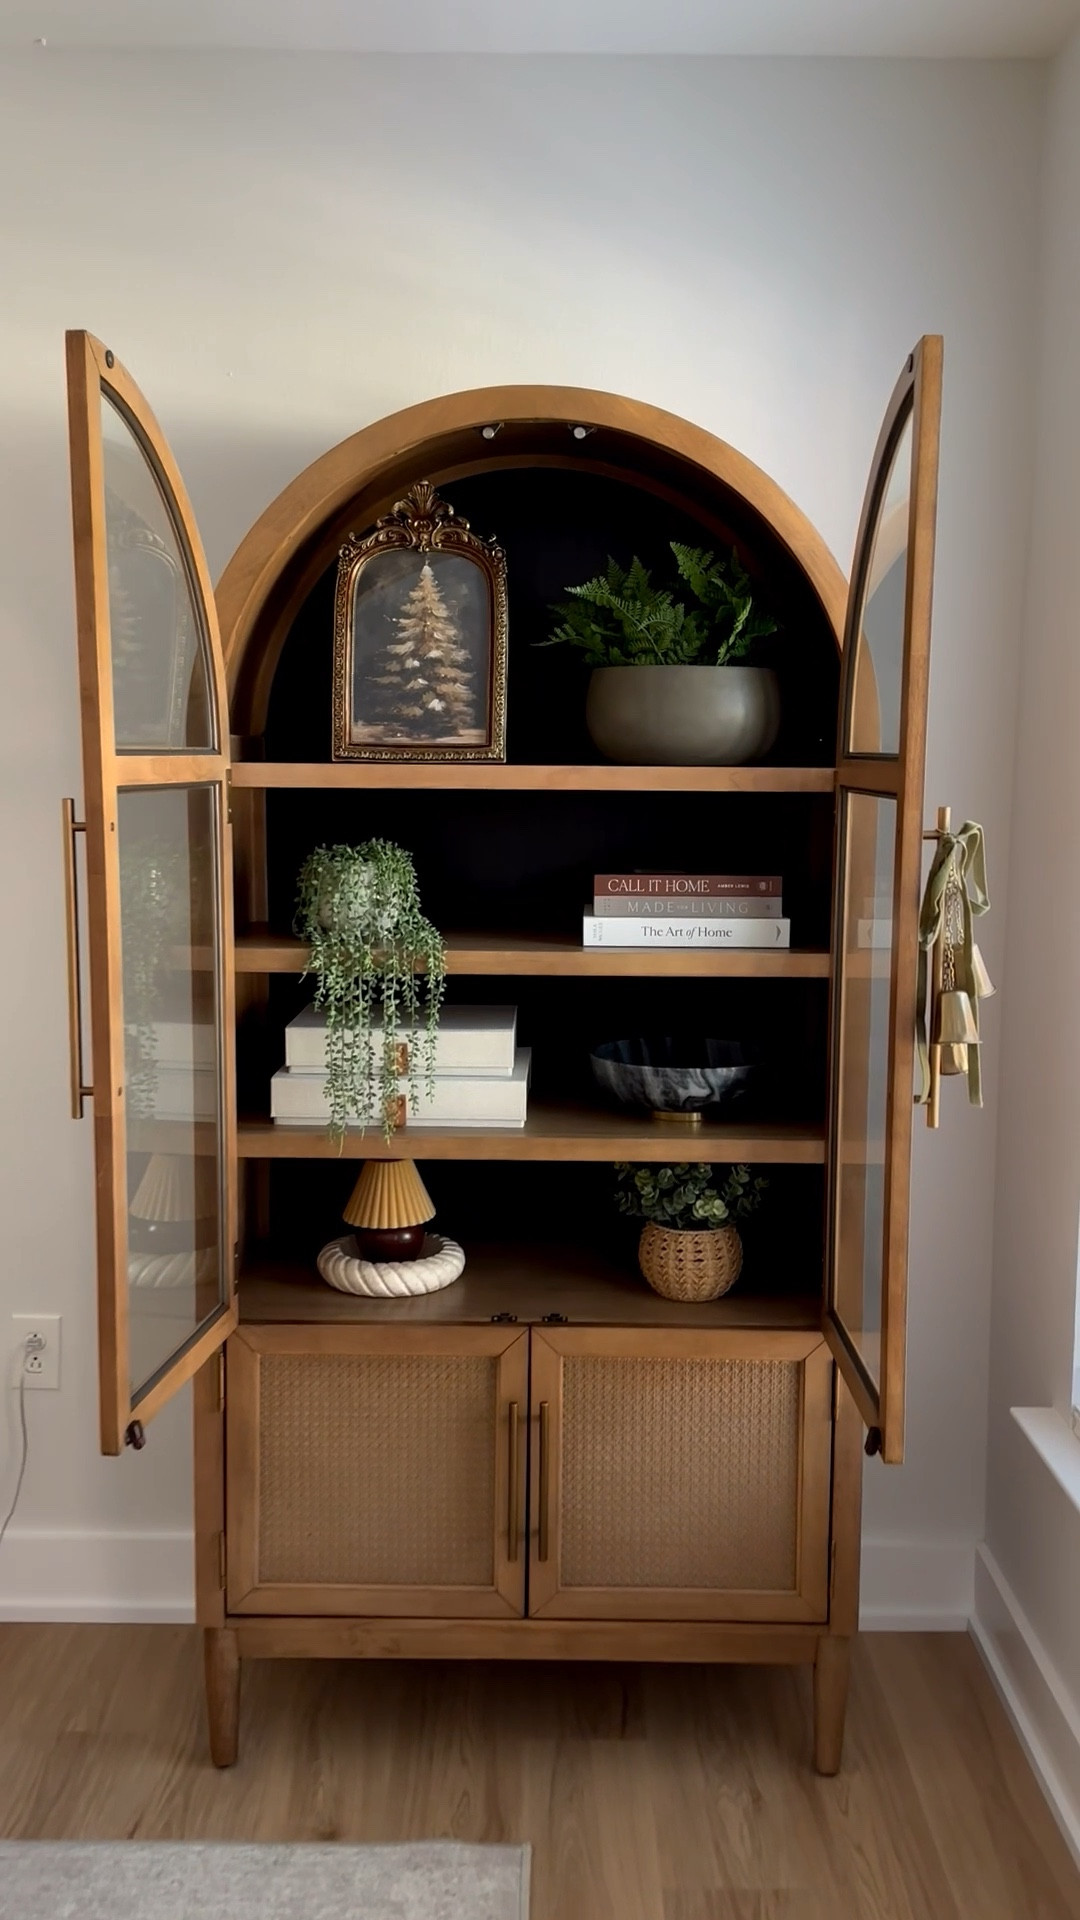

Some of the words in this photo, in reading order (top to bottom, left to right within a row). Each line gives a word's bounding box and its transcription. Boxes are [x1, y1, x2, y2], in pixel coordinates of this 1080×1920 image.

[608, 879, 645, 892] CALL
[649, 879, 662, 892] IT
[665, 879, 710, 893] HOME
[627, 901, 674, 913] MADE
[691, 901, 749, 914] LIVING
[641, 926, 664, 937] The
[665, 926, 683, 937] Art
[685, 925, 696, 939] of
[697, 926, 733, 938] Home
